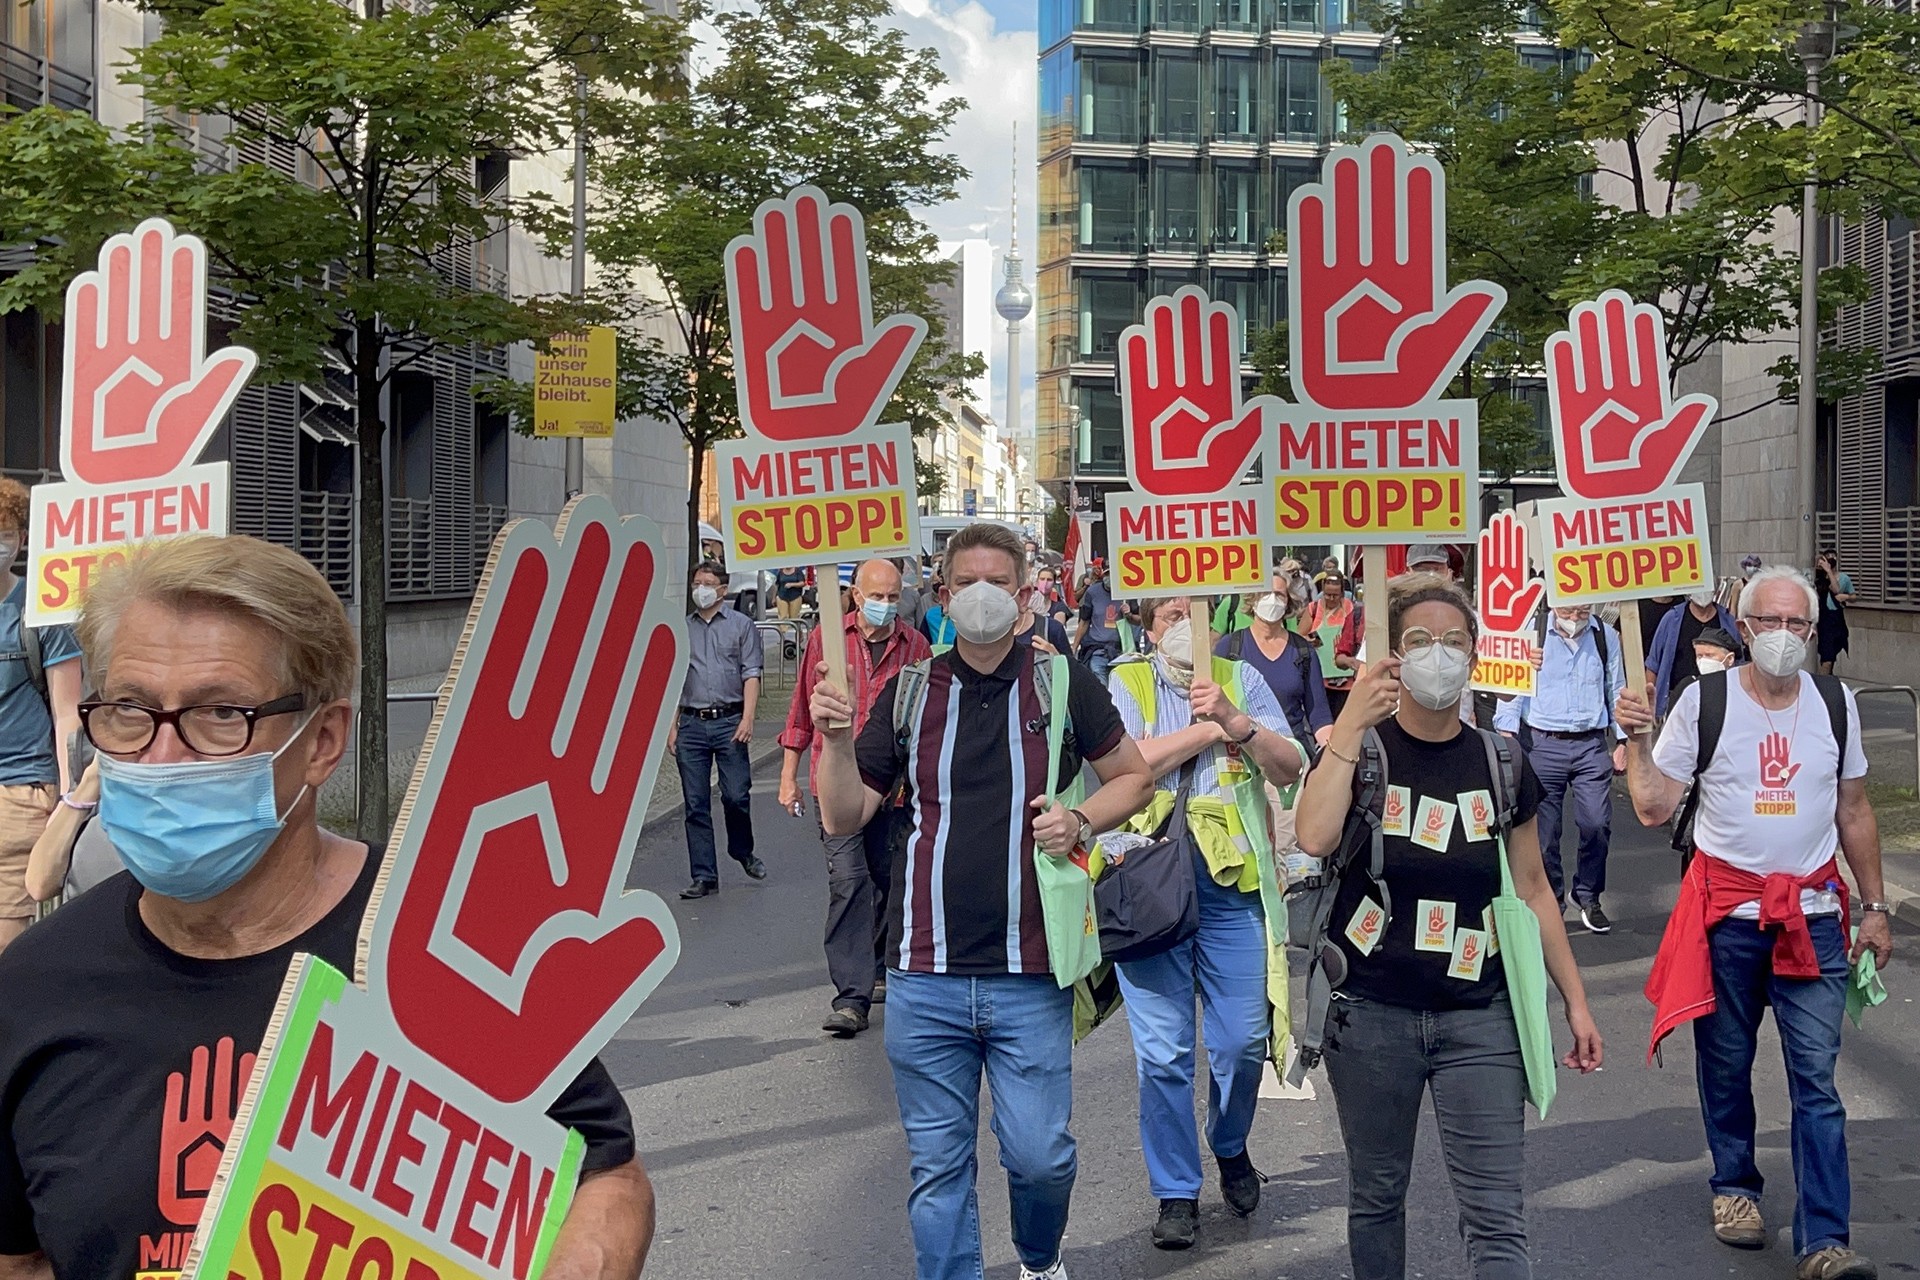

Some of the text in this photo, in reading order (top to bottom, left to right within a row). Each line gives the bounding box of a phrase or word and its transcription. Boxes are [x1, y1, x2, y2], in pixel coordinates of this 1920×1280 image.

[539, 359, 587, 371] unser
[539, 372, 612, 388] Zuhause
[538, 388, 591, 402] bleibt.
[538, 420, 559, 431] Ja!
[1279, 418, 1460, 470] MIETEN
[732, 441, 899, 501] MIETEN
[45, 482, 210, 549] MIETEN
[737, 496, 904, 556] STOPP!
[1119, 500, 1257, 542] MIETEN
[1279, 478, 1461, 530] STOPP!
[1552, 498, 1694, 549] MIETEN
[1122, 544, 1260, 586] STOPP!
[1557, 543, 1699, 594] STOPP!
[1755, 790, 1795, 801] MIETEN
[1755, 803, 1796, 815] STOPP!
[276, 1020, 555, 1280] MIETEN
